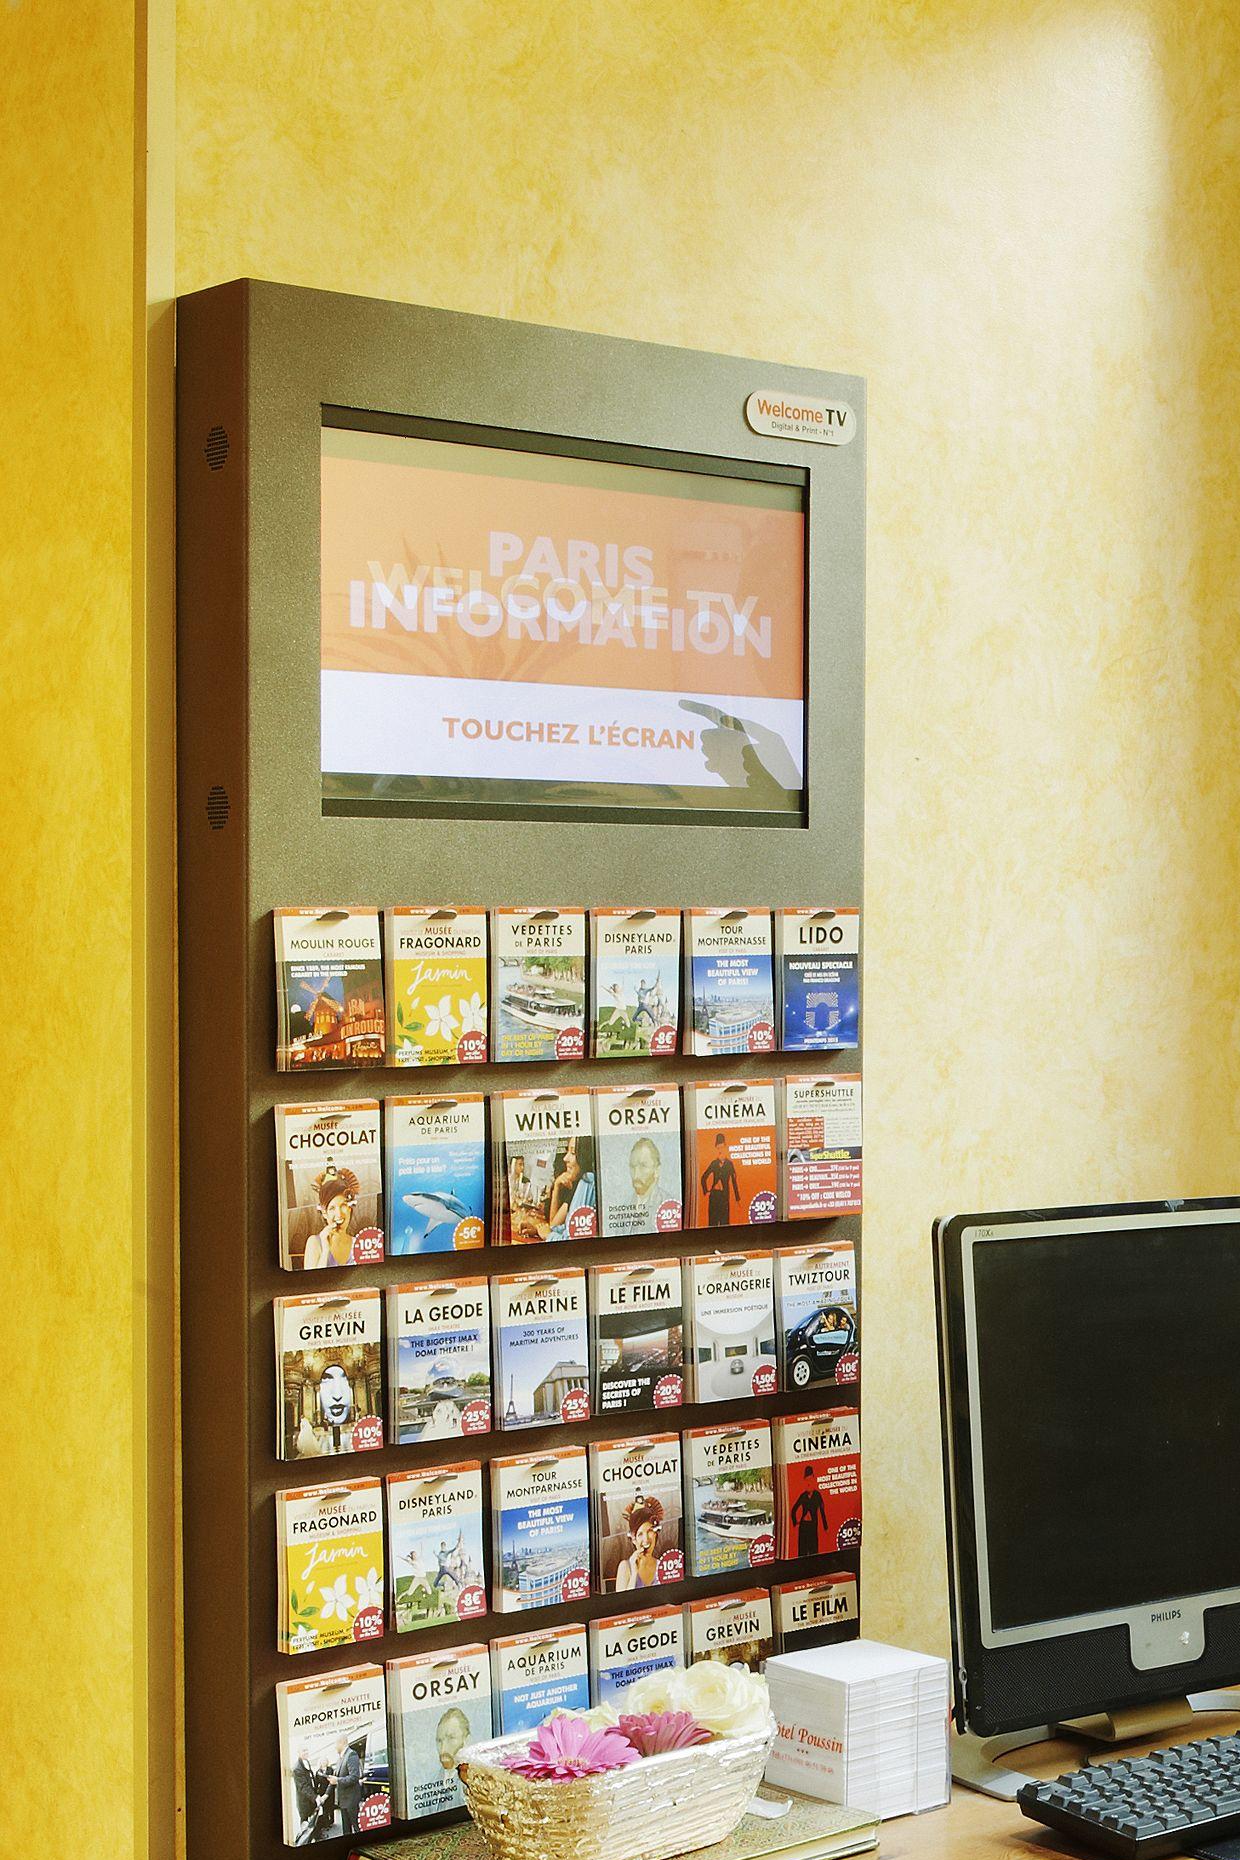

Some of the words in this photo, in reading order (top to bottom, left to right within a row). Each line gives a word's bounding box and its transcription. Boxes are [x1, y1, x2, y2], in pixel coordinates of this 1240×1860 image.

[757, 399, 824, 423] Welcome
[826, 409, 847, 426] TV
[772, 421, 793, 431] Digital
[802, 426, 817, 435] Print
[489, 531, 655, 588] PARIS
[367, 561, 669, 630] WELCOME
[687, 591, 759, 637] TV
[349, 581, 772, 658] INFORMATION
[442, 717, 580, 745] TOUCHEZ
[589, 720, 695, 750] L'ÉCRAN
[512, 925, 572, 935] VEDETTES
[605, 933, 672, 943] DISNEYLAND
[720, 926, 743, 934] TOUR
[800, 927, 843, 944] LIDO
[291, 939, 334, 949] MOULIN
[339, 938, 374, 948] ROUGE
[400, 937, 481, 949] FRAGONARD
[527, 937, 562, 947] PARIS
[625, 945, 652, 954] PARIS
[698, 937, 766, 946] MONTPARNASSE
[407, 960, 472, 995] Jasmin
[794, 1089, 854, 1098] SUPERSHUTTLE
[609, 1107, 671, 1126] ORSAY
[705, 1100, 766, 1119] CINÉMA
[408, 1114, 470, 1127] AQUARIUM
[515, 1110, 580, 1131] WINE!
[421, 1127, 432, 1135] DE
[435, 1126, 458, 1134] PARIS
[289, 1129, 377, 1149] CHOCOLAT
[354, 1238, 383, 1251] -10%
[815, 1260, 850, 1270] AUTREMENT
[788, 1269, 850, 1286] TWIZTOUR
[610, 1288, 627, 1305] LE
[633, 1283, 671, 1302] FILM
[697, 1277, 771, 1296] L'ORANGERIE
[405, 1308, 424, 1325] LA
[429, 1302, 483, 1321] GEODE
[508, 1296, 578, 1317] MARINE
[299, 1321, 365, 1341] GREVIN
[523, 1330, 535, 1338] 300
[536, 1327, 556, 1335] YEARS
[411, 1339, 425, 1348] THE
[426, 1336, 457, 1347] BIGGEST
[458, 1333, 478, 1343] IMAX
[510, 1337, 539, 1347] MARITIME
[540, 1333, 579, 1345] ADVENTURES
[415, 1348, 437, 1358] DOME
[439, 1346, 469, 1356] THEATRE
[602, 1379, 637, 1391] DISCOVER
[638, 1377, 651, 1387] THE
[602, 1389, 631, 1400] SECRETS
[602, 1401, 622, 1410] PARIS
[704, 1438, 760, 1456] VEDETTES
[793, 1430, 852, 1454] CINÉMA
[718, 1451, 751, 1465] PARIS
[532, 1471, 557, 1483] TOUR
[602, 1459, 678, 1483] CHOCOLAT
[506, 1479, 583, 1499] MONTPARNASSE
[399, 1489, 474, 1510] DISNEYLAND
[422, 1504, 453, 1518] PARIS
[528, 1509, 542, 1518] THE
[542, 1505, 564, 1515] MOST
[292, 1510, 377, 1534] FRAGONARD
[517, 1516, 555, 1530] BEAUTIFUL
[556, 1512, 574, 1523] VIEW
[529, 1528, 540, 1537] OF
[301, 1541, 369, 1580] Jasmin
[792, 1605, 807, 1622] LE
[813, 1597, 848, 1618] FILM
[1151, 1609, 1182, 1623] PHILIPS
[706, 1619, 760, 1641] GREVIN
[605, 1642, 623, 1658] LA
[628, 1631, 677, 1652] GEODE
[508, 1646, 581, 1670] AQUARIUM
[525, 1667, 535, 1676] DE
[539, 1662, 565, 1673] PARIS
[611, 1671, 623, 1679] THE
[626, 1665, 653, 1676] BIGGEST
[655, 1660, 673, 1670] IMAX
[412, 1672, 480, 1700] ORSAY
[616, 1678, 635, 1688] DOME
[341, 1693, 370, 1705] NAVETTE
[514, 1694, 529, 1703] NOT
[530, 1691, 545, 1699] JUST
[547, 1683, 578, 1696] ANOTHER
[526, 1696, 563, 1709] AQUARIUM
[293, 1709, 339, 1728] AIRPORT
[340, 1700, 381, 1717] SHUTTLE
[799, 1728, 843, 1753] Poussin
[413, 1781, 443, 1792] DISCOVER
[413, 1785, 458, 1801] OUTSTANDING
[414, 1795, 453, 1810] COLLECTIONS
